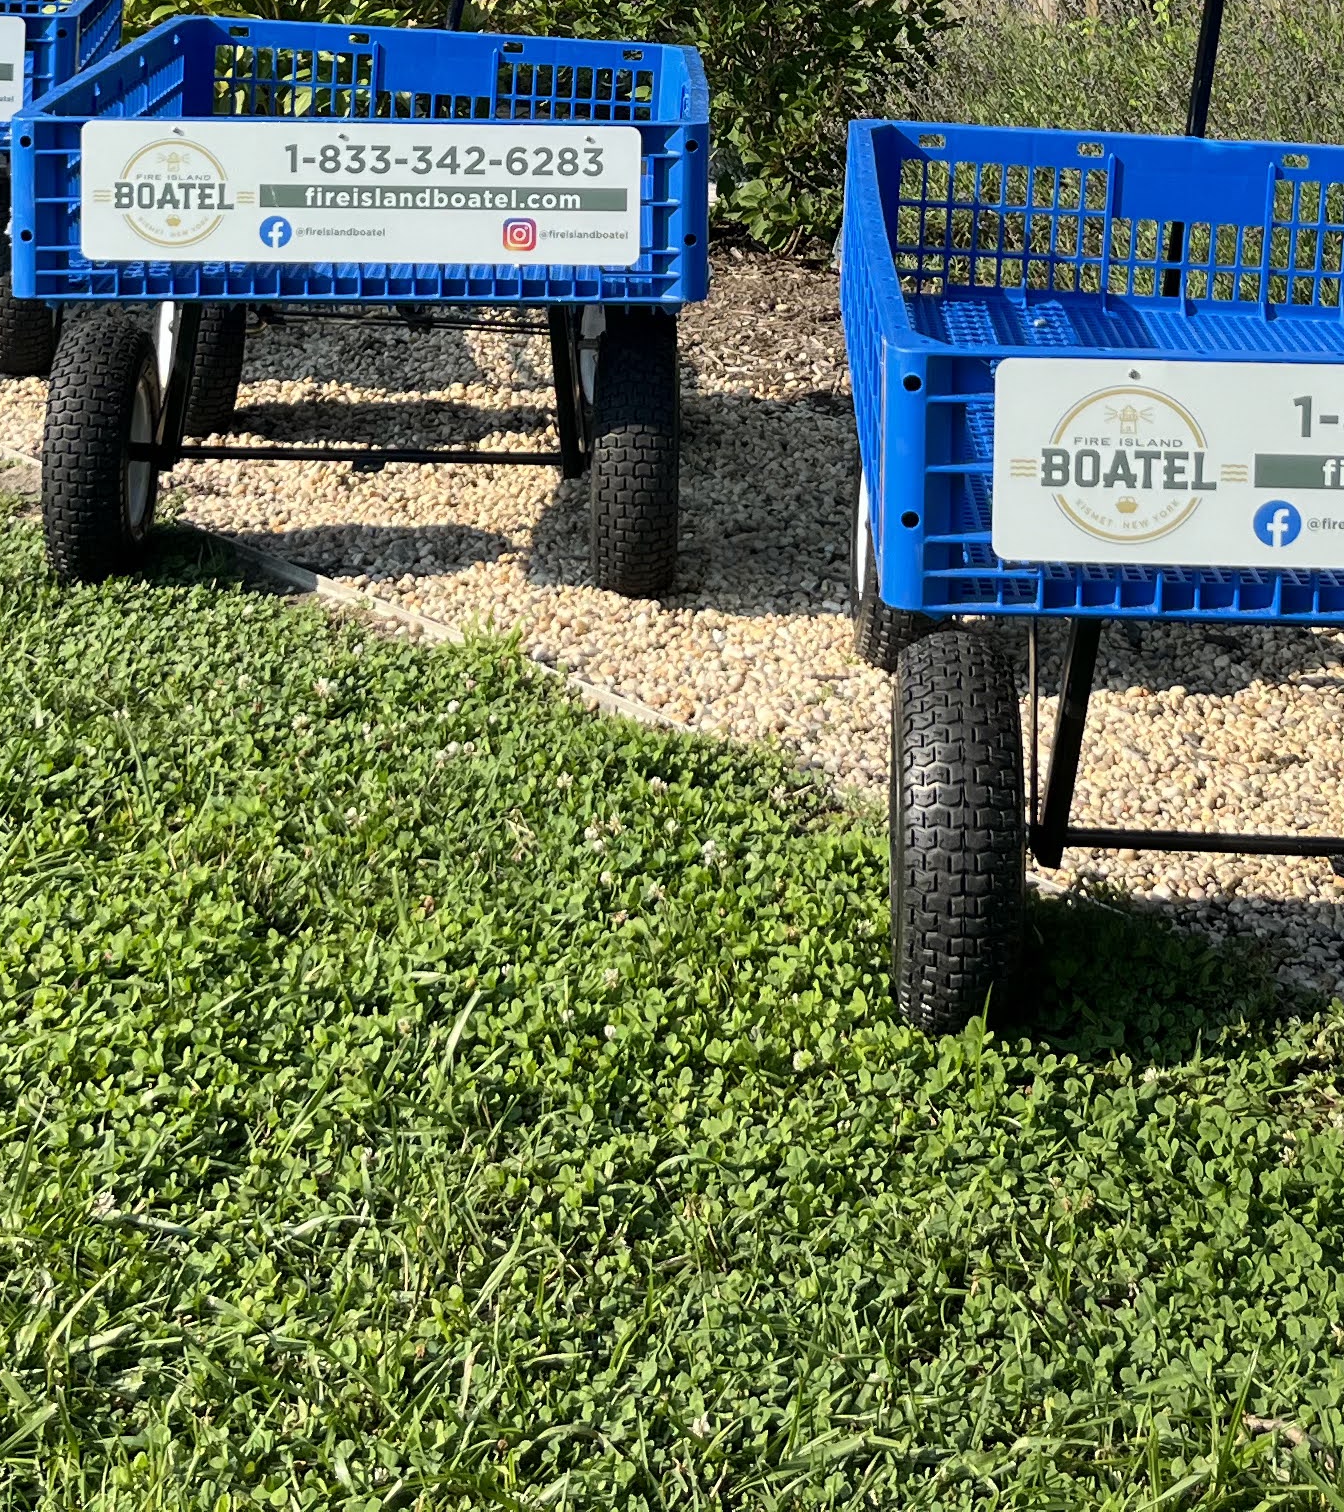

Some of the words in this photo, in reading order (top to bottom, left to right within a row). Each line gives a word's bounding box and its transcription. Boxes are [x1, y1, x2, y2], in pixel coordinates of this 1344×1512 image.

[285, 143, 604, 176] 1-833-342-6283
[114, 182, 234, 210] BOATEL
[305, 187, 581, 209] fireislandboatel.com
[295, 227, 386, 237] @fireislandboatel
[538, 230, 628, 240] @fireislandboatel
[1074, 437, 1111, 446] FIRE
[1119, 437, 1184, 448] ISLAND
[1041, 447, 1217, 490] BOATEL
[1122, 518, 1150, 529] NEW
[1152, 498, 1180, 523] YORK
